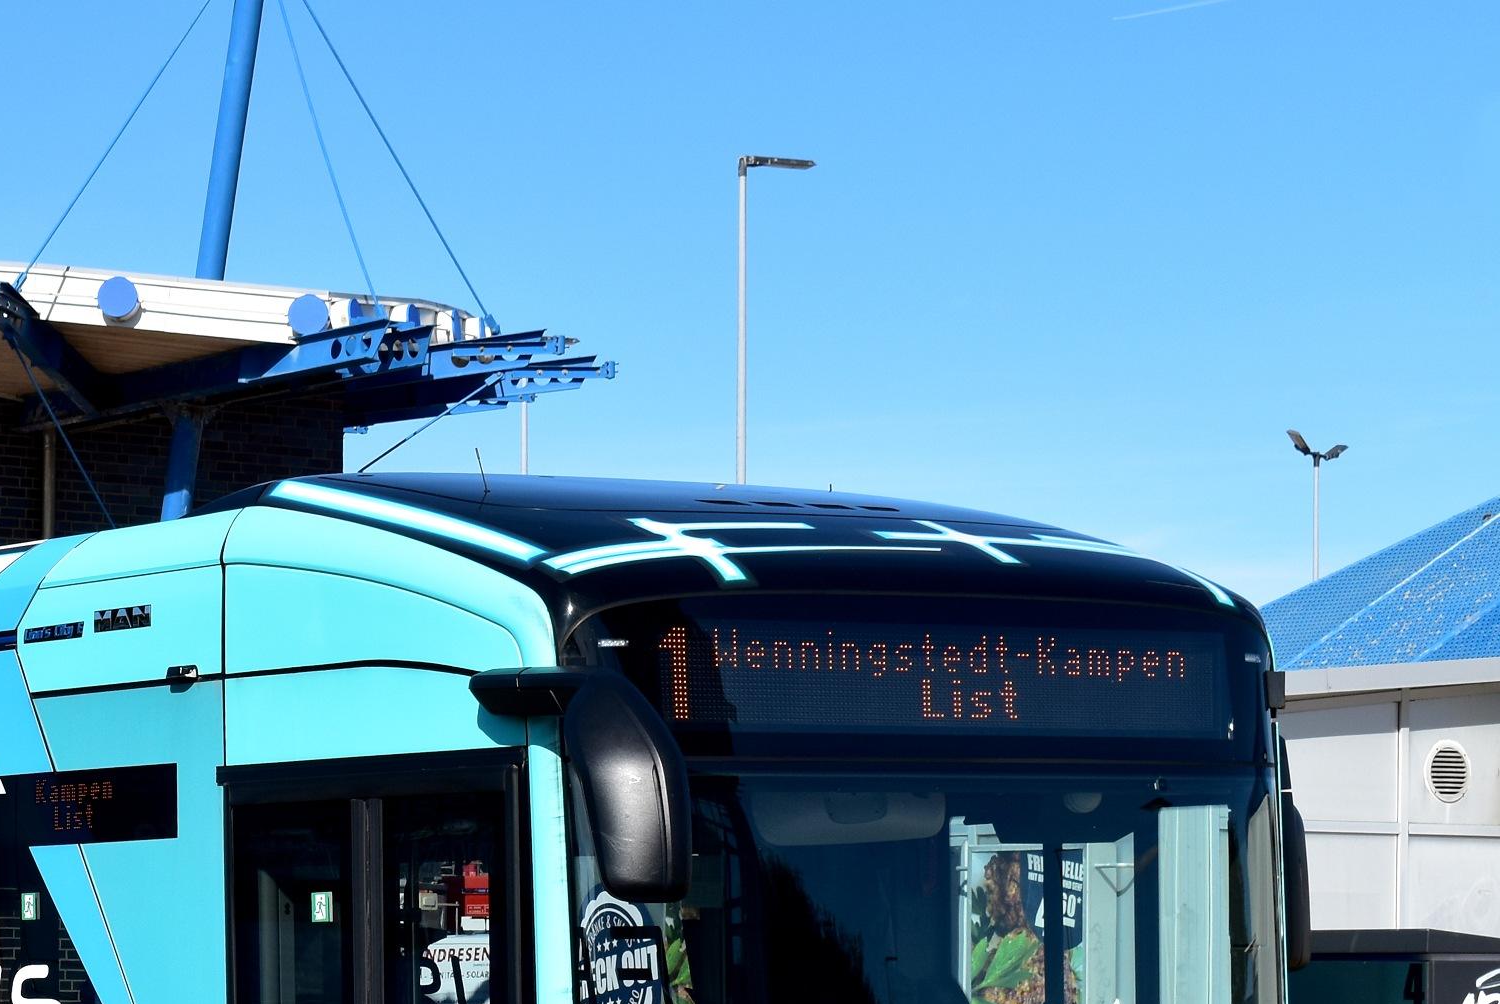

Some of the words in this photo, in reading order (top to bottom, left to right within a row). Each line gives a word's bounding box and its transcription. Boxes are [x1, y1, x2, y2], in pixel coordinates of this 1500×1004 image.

[94, 605, 151, 632] MAN
[659, 626, 689, 720] 1
[711, 626, 1187, 683] Wenningstedt-Kampen
[920, 679, 1020, 720] List
[35, 779, 113, 805] Kampen
[53, 804, 93, 831] List
